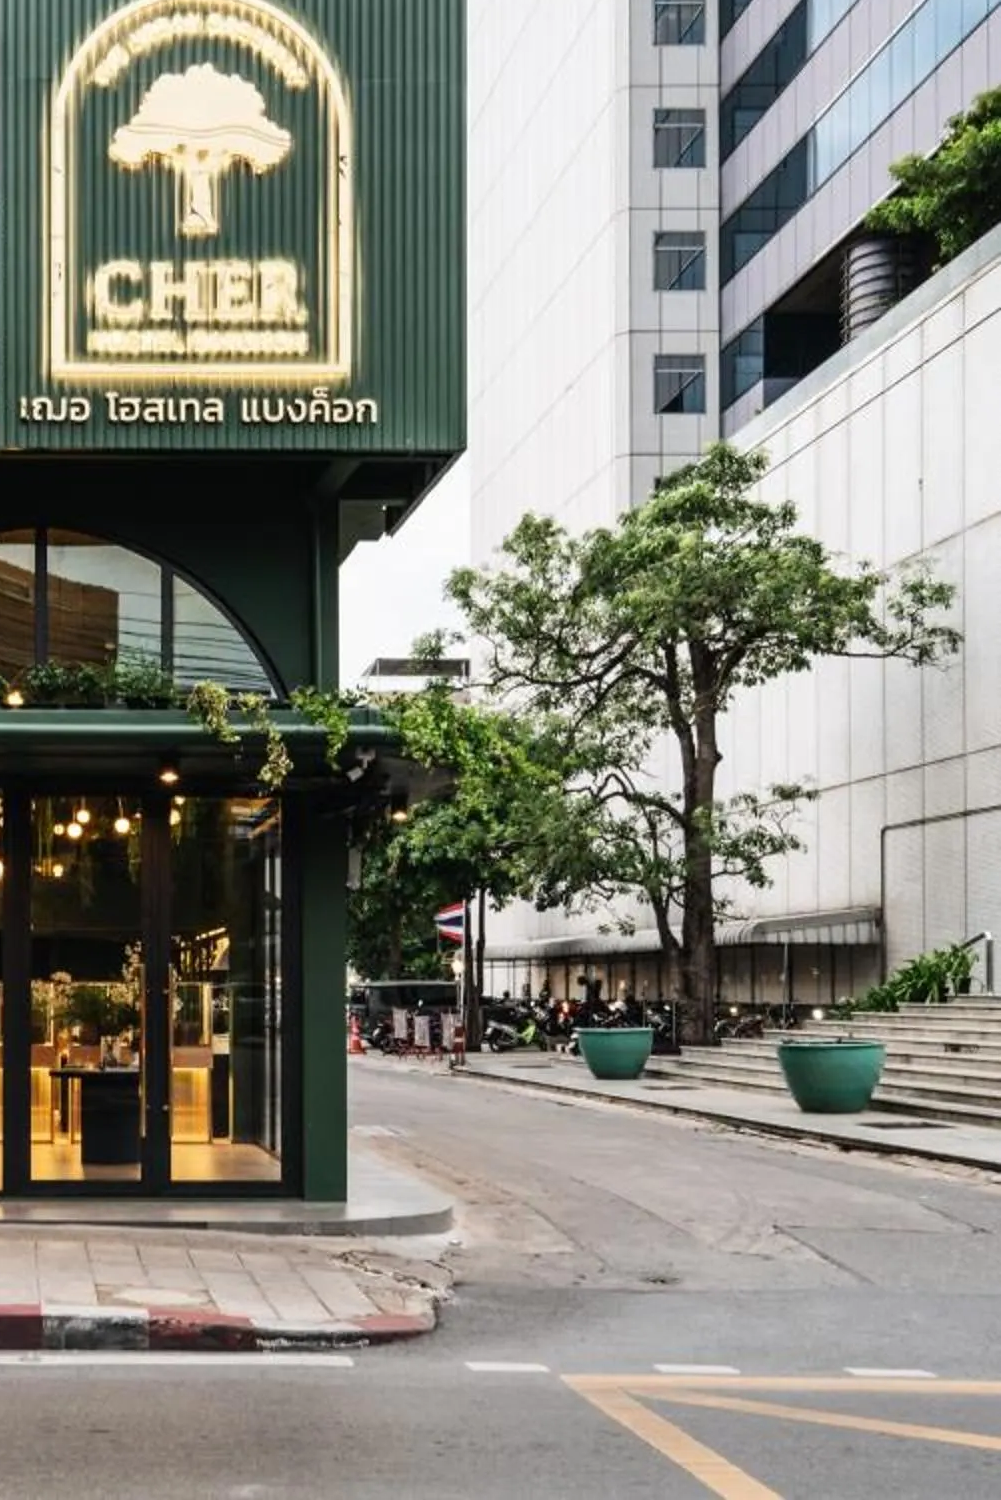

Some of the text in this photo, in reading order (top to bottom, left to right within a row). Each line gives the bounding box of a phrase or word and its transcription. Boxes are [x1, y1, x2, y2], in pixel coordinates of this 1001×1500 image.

[93, 259, 308, 324] CHER
[20, 386, 378, 423] เฌอ โฮสเทล แบงค็อก
